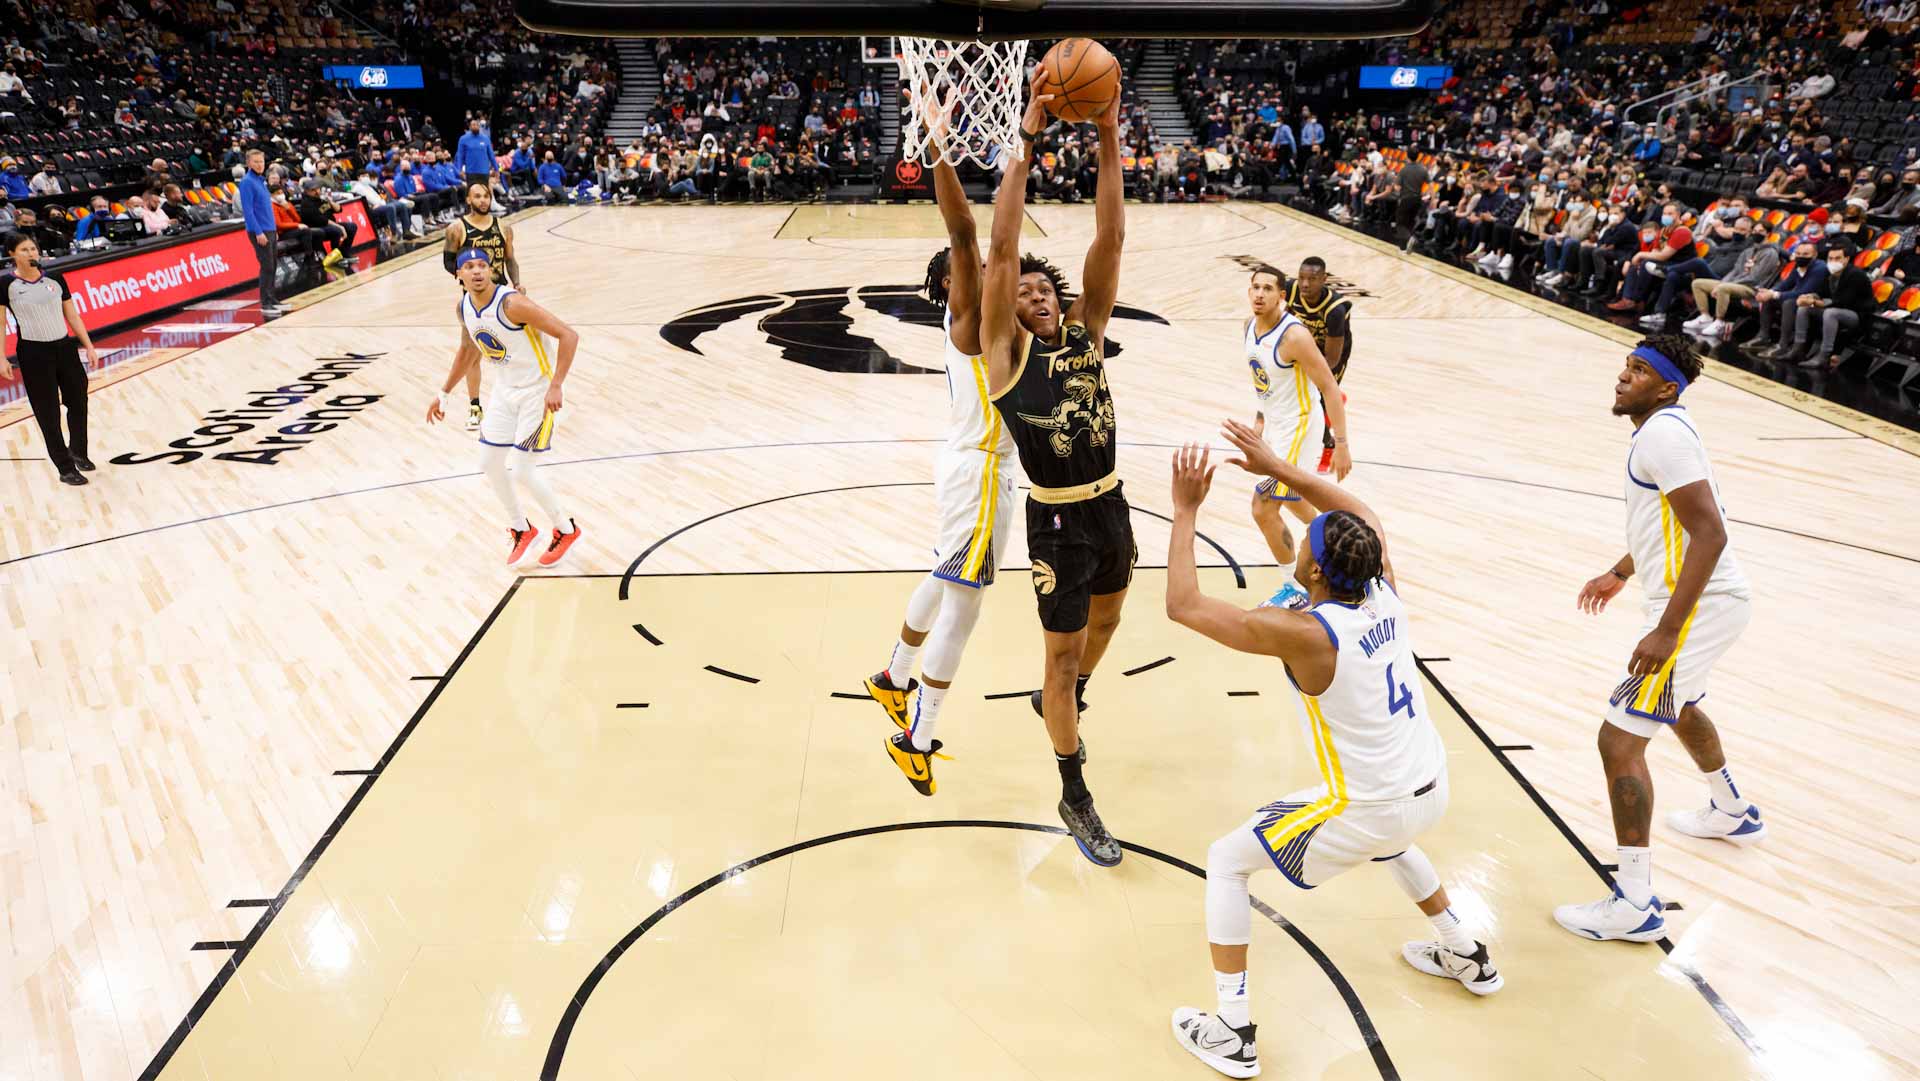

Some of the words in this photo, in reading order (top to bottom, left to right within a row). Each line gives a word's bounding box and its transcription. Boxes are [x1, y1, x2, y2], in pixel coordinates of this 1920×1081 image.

[84, 261, 189, 310] home-court
[190, 252, 229, 279] fans.
[109, 352, 388, 465] Scotiabank
[212, 394, 386, 465] Arena
[1358, 617, 1396, 658] MOODY
[1386, 662, 1416, 719] 4
